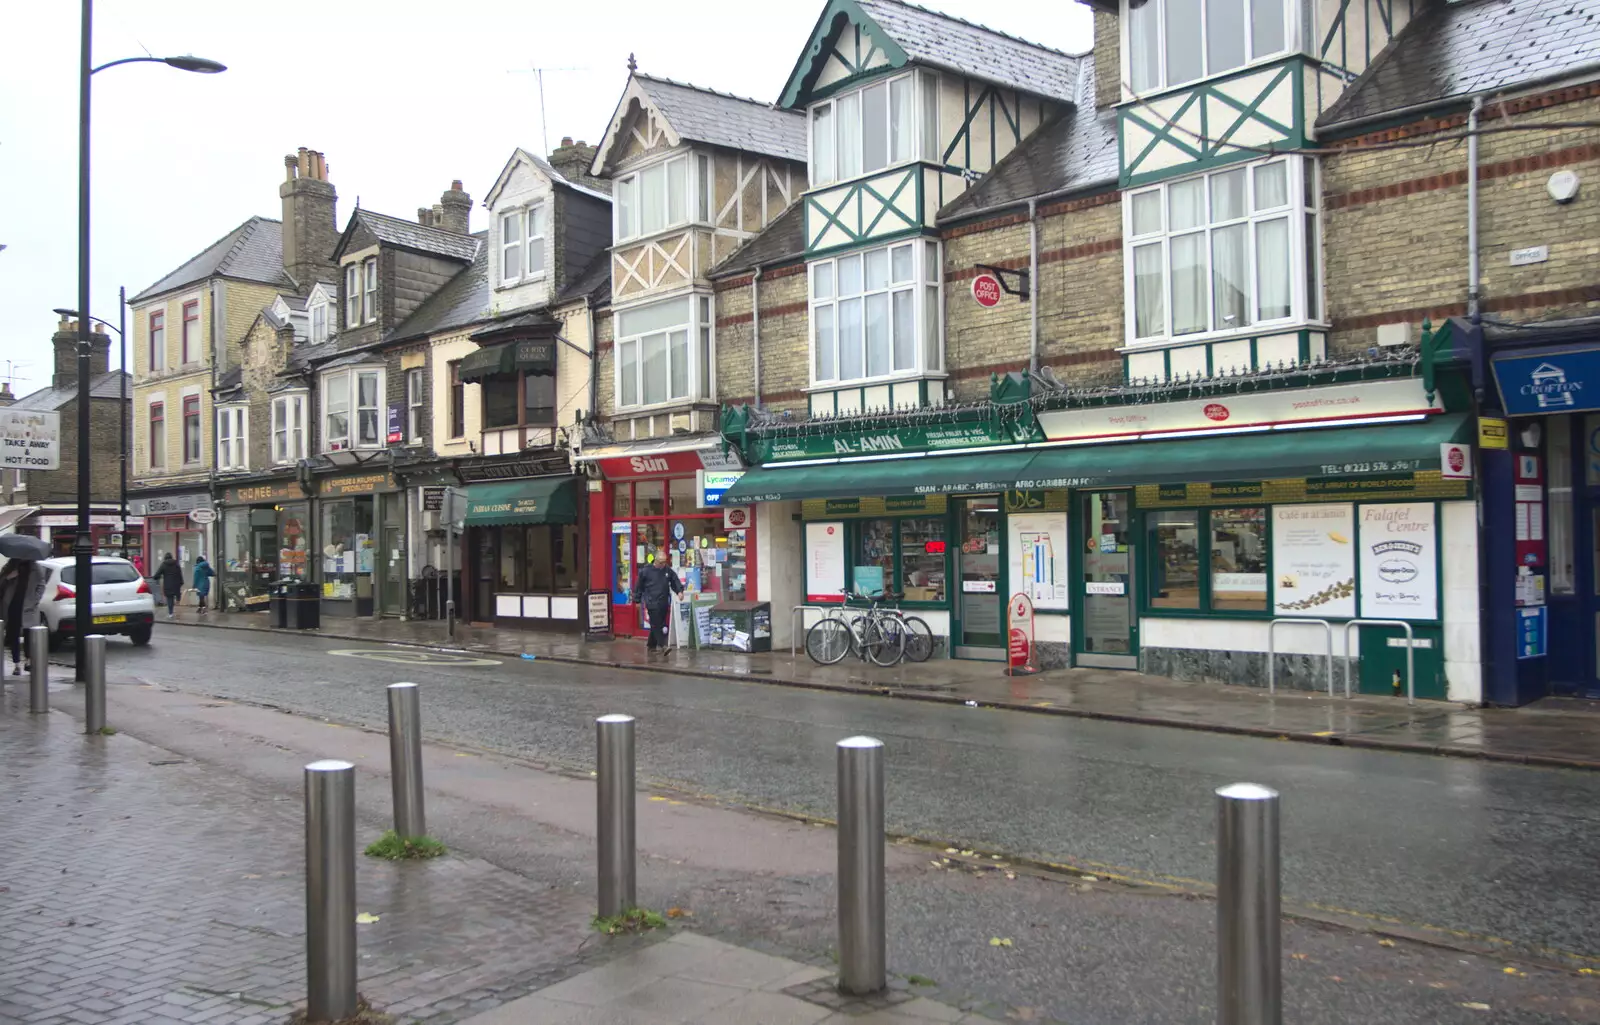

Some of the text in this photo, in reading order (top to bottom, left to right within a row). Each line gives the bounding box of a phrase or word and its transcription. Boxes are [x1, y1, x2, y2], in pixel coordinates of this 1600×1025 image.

[979, 281, 996, 291] POST
[976, 289, 999, 301] OFFICE
[1520, 381, 1584, 396] CROFTON
[925, 430, 945, 439] FRESH
[945, 429, 962, 437] FRUIT
[4, 439, 50, 449] TAKE AWAY
[832, 433, 904, 453] AL-AMIN
[927, 434, 991, 446] CONVENIENCE STORE
[5, 456, 49, 466] HOT FOOD
[630, 455, 669, 473] Sun
[1320, 464, 1342, 474] TEL:
[706, 475, 740, 485] Lycamob
[1015, 479, 1034, 488] AFRO
[1035, 477, 1079, 487] CARIBBEAN
[1364, 507, 1410, 521] Falafel
[1387, 521, 1429, 532] Centre
